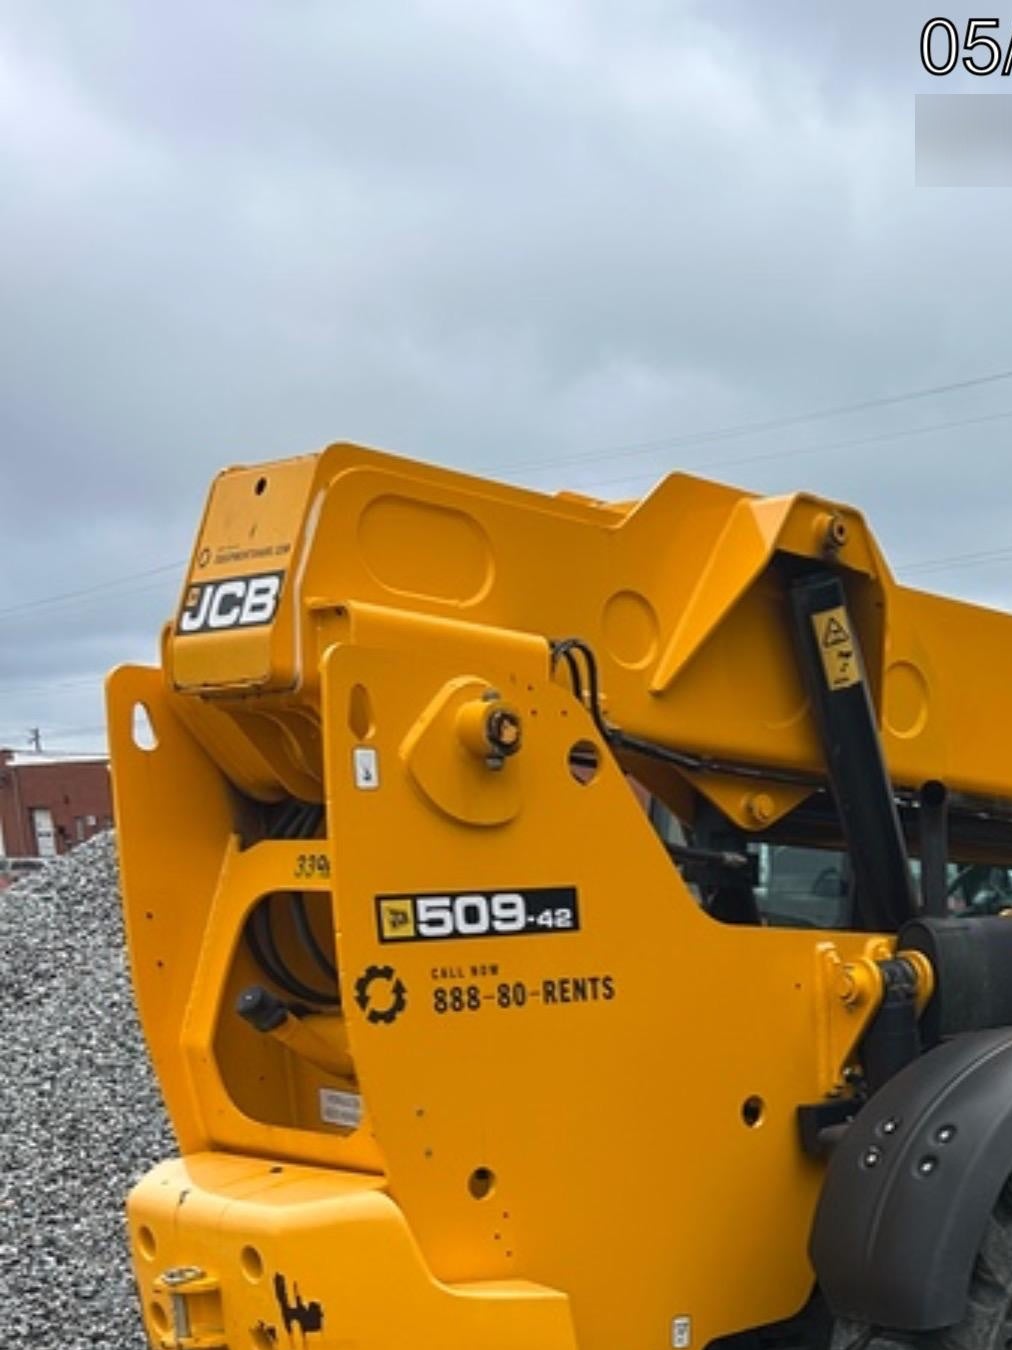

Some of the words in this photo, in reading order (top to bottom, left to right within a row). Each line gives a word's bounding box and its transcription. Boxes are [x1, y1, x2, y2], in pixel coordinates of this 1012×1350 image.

[181, 576, 280, 631] JCB
[431, 967, 465, 980] CALL
[471, 963, 499, 976] NOW
[433, 976, 615, 1014] 888-80-RENTS
